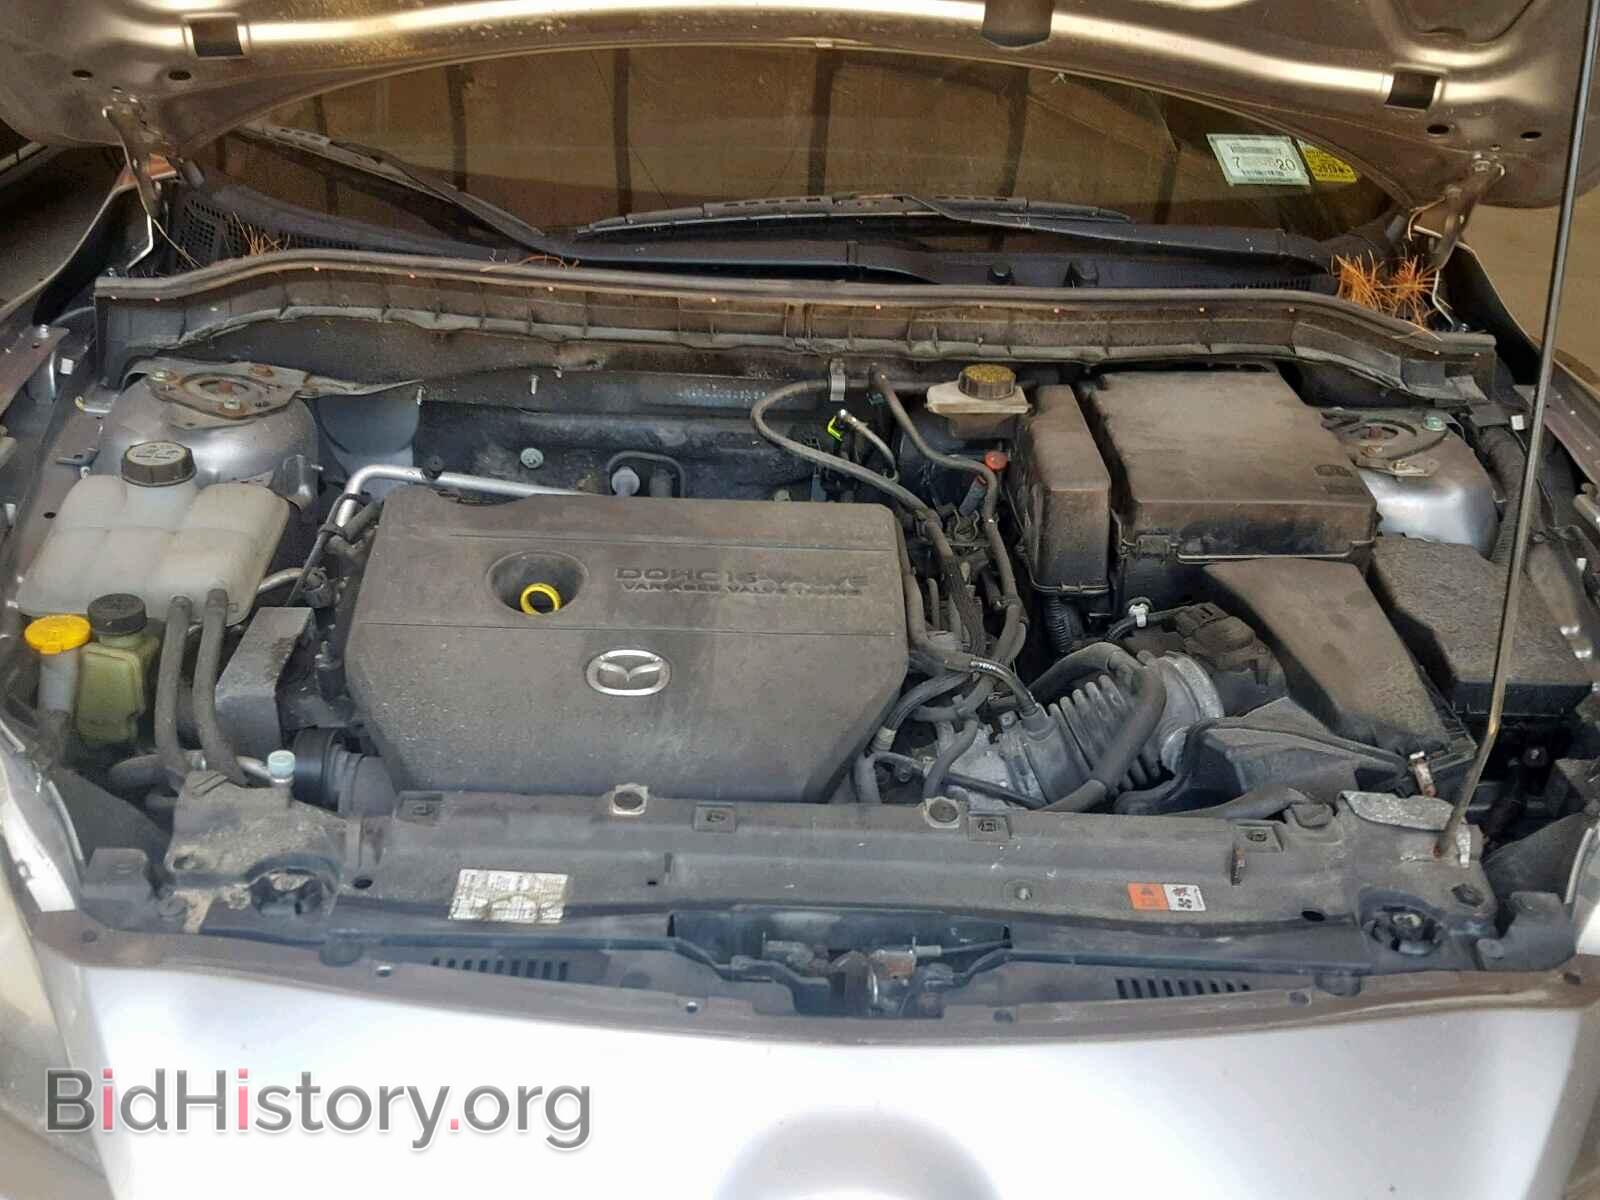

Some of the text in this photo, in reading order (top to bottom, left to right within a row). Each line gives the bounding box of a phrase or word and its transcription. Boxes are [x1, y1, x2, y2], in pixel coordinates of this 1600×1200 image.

[1231, 156, 1241, 169] 7
[1275, 158, 1296, 171] 20
[615, 567, 721, 582] DOHC
